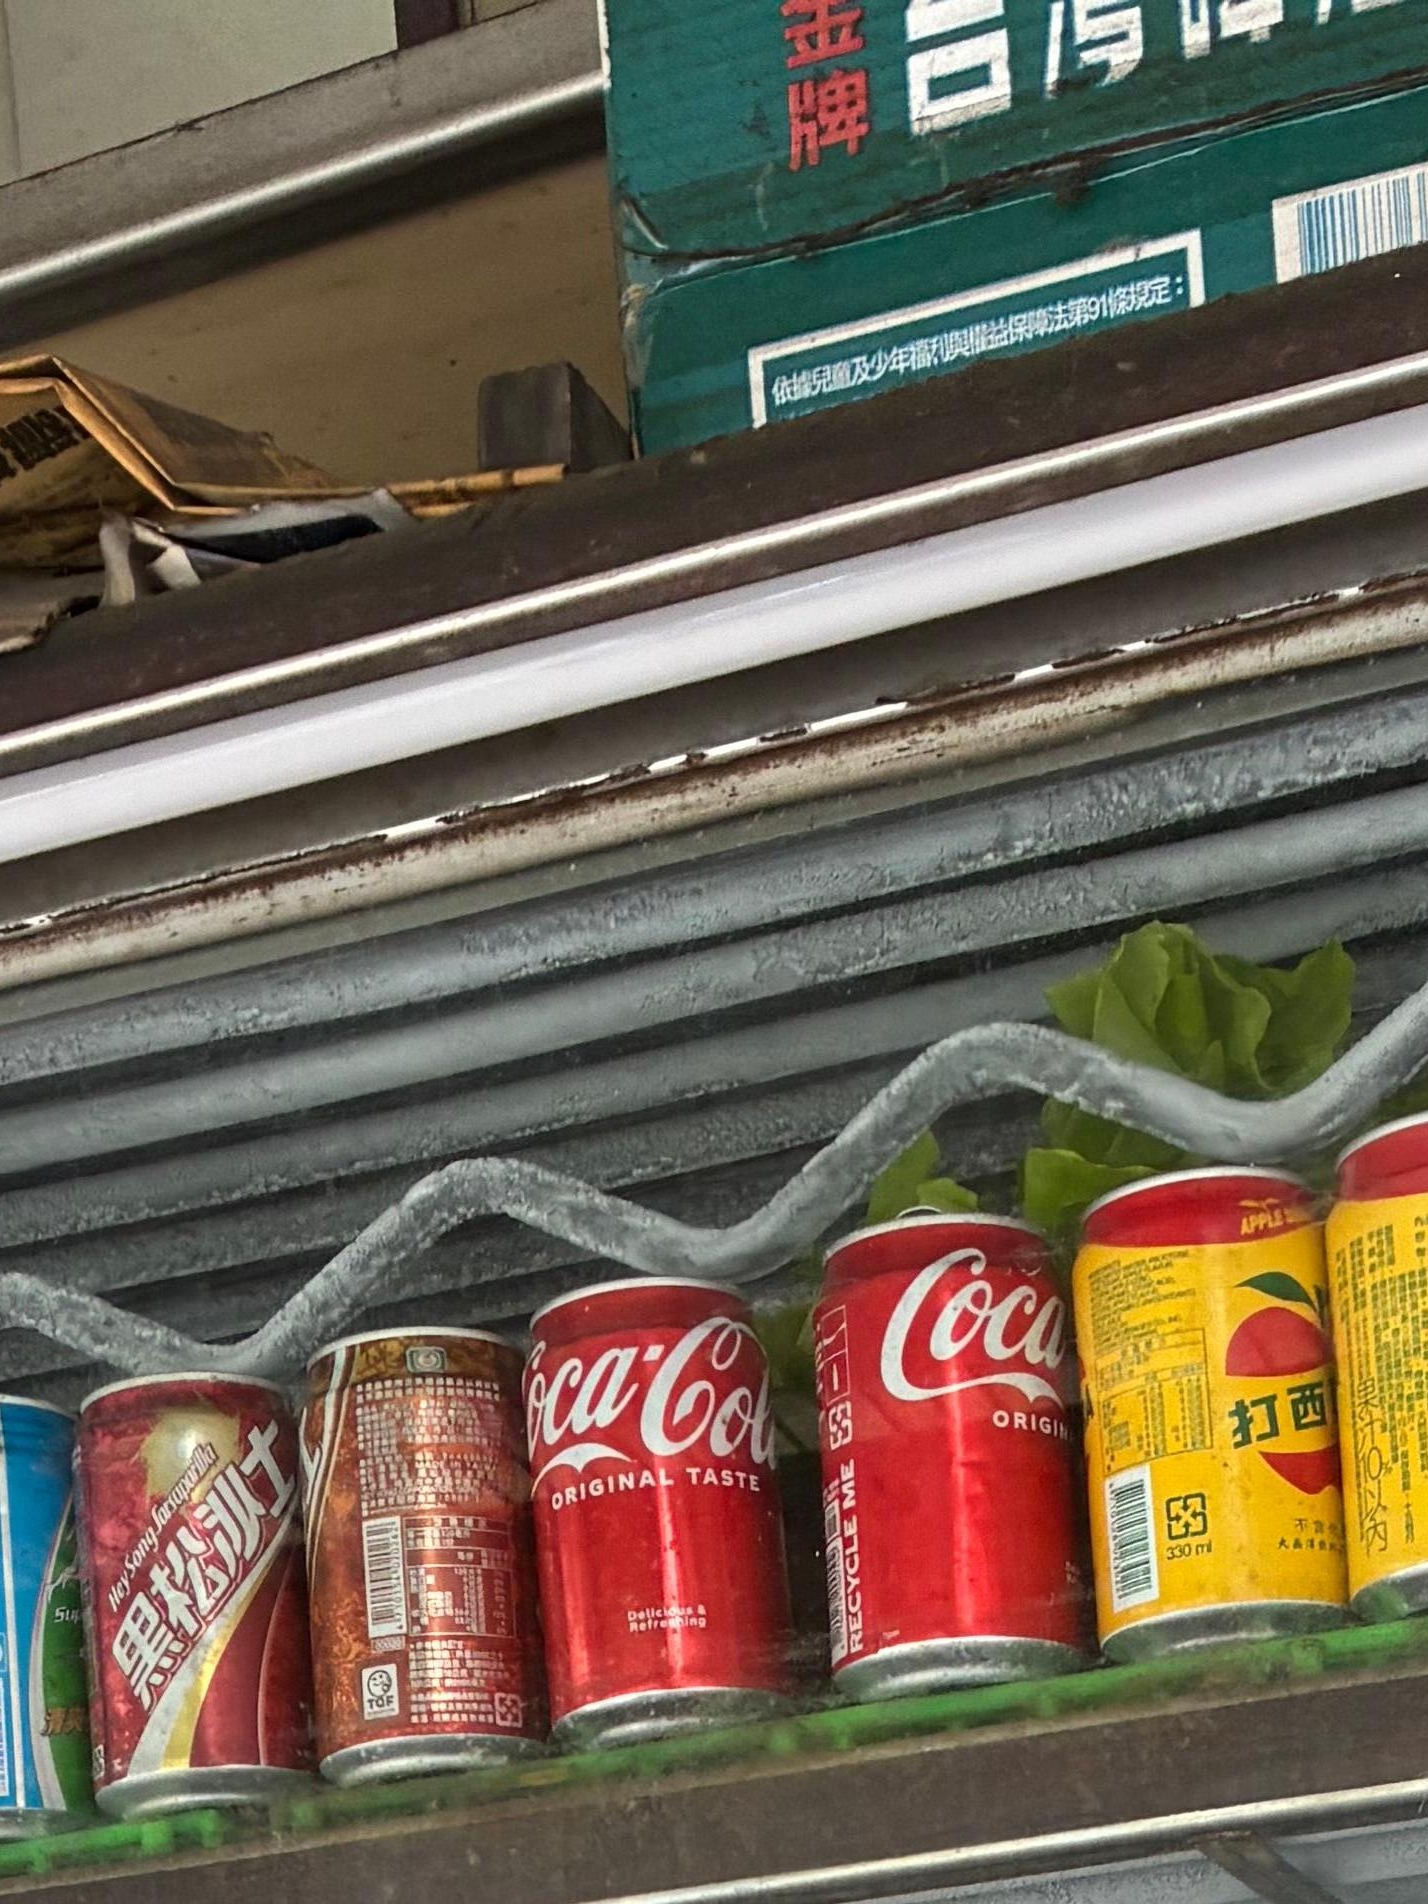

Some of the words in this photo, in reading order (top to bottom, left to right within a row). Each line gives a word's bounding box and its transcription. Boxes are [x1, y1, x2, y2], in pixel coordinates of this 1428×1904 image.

[1240, 1211, 1283, 1236] APPLE
[551, 1468, 675, 1511] ORIGINAL
[685, 1467, 761, 1492] TASTE
[840, 1458, 855, 1509] ME
[111, 1419, 296, 1712] 黑松沙士
[1166, 1542, 1191, 1561] 330
[1195, 1540, 1212, 1556] ml
[842, 1516, 865, 1652] RECYCLE
[627, 1606, 694, 1623] Delicious
[628, 1615, 707, 1633] Refreshing
